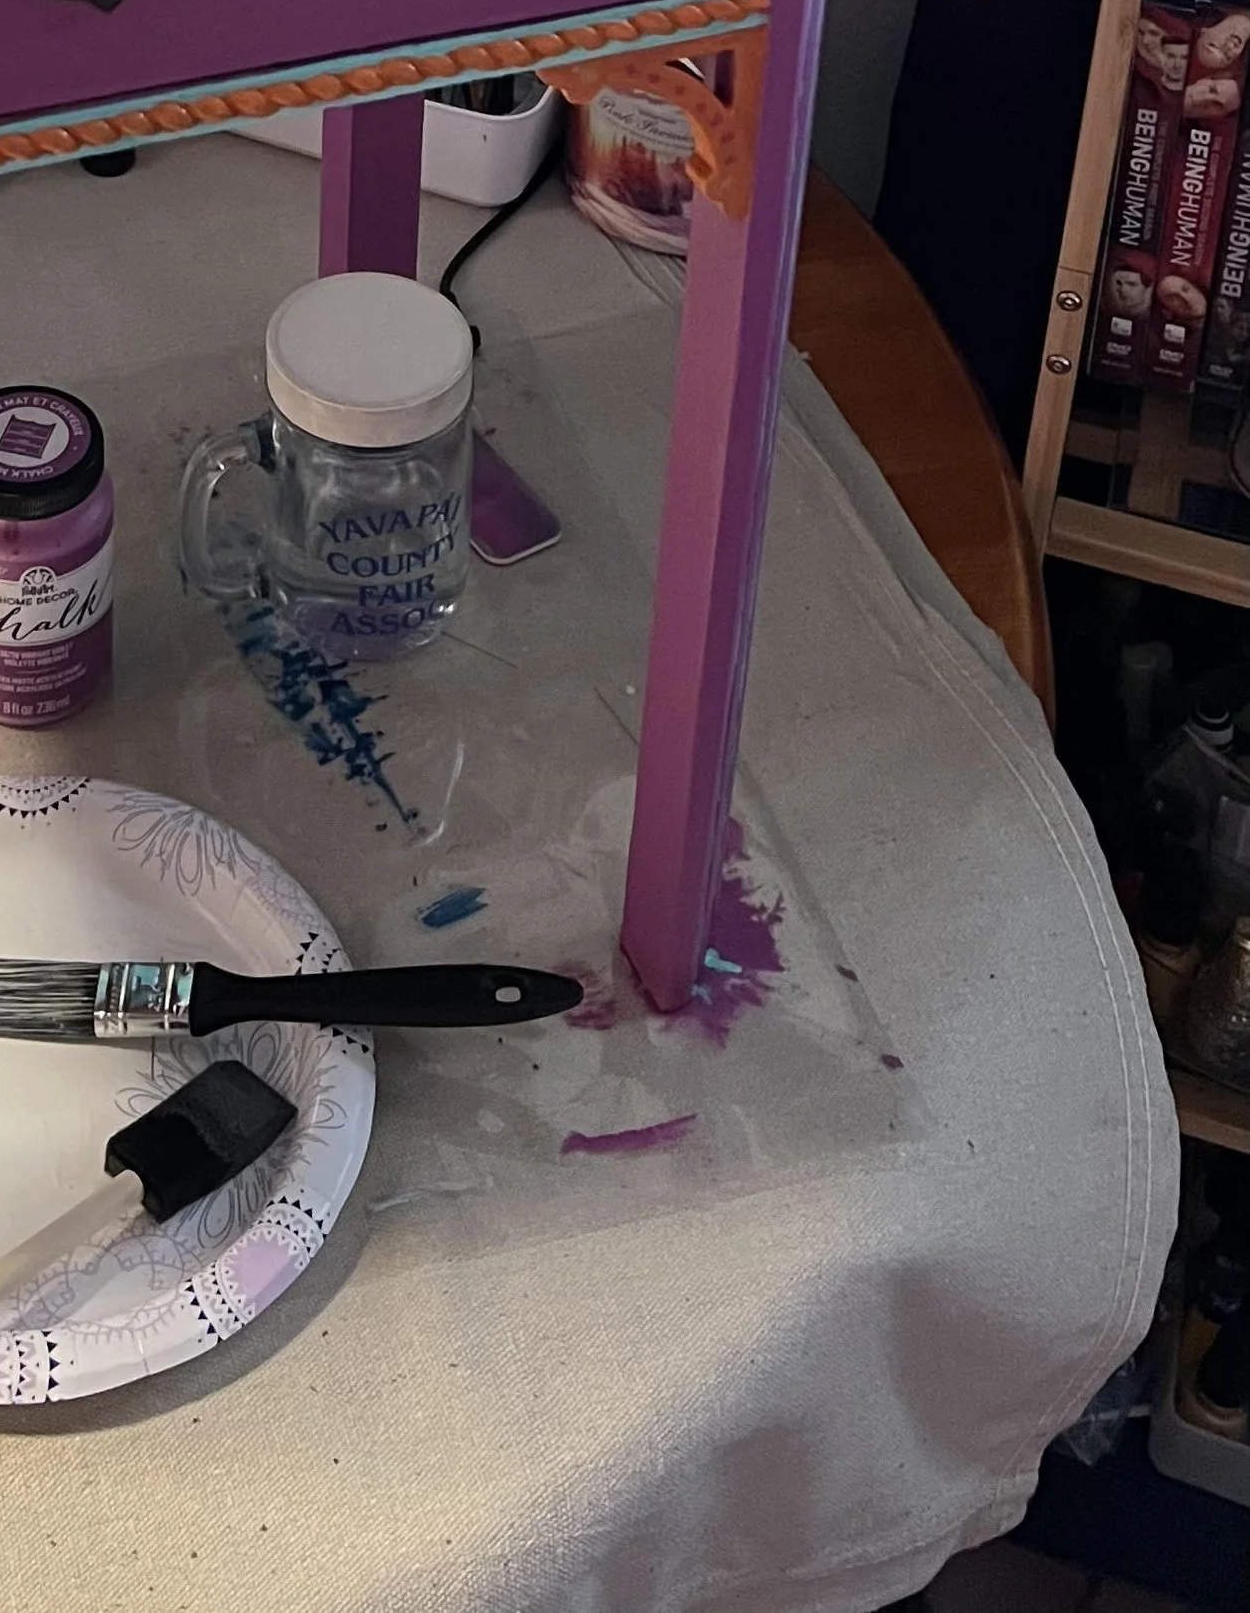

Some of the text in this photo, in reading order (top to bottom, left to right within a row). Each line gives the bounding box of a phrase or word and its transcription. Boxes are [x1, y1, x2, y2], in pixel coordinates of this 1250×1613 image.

[4, 396, 29, 407] MAT
[32, 397, 47, 406] ET
[10, 466, 54, 479] CHALK
[318, 492, 462, 543] YAVAPAI
[326, 525, 459, 578] COUNTY
[36, 588, 76, 605] DECOR
[357, 573, 436, 607] FAIR
